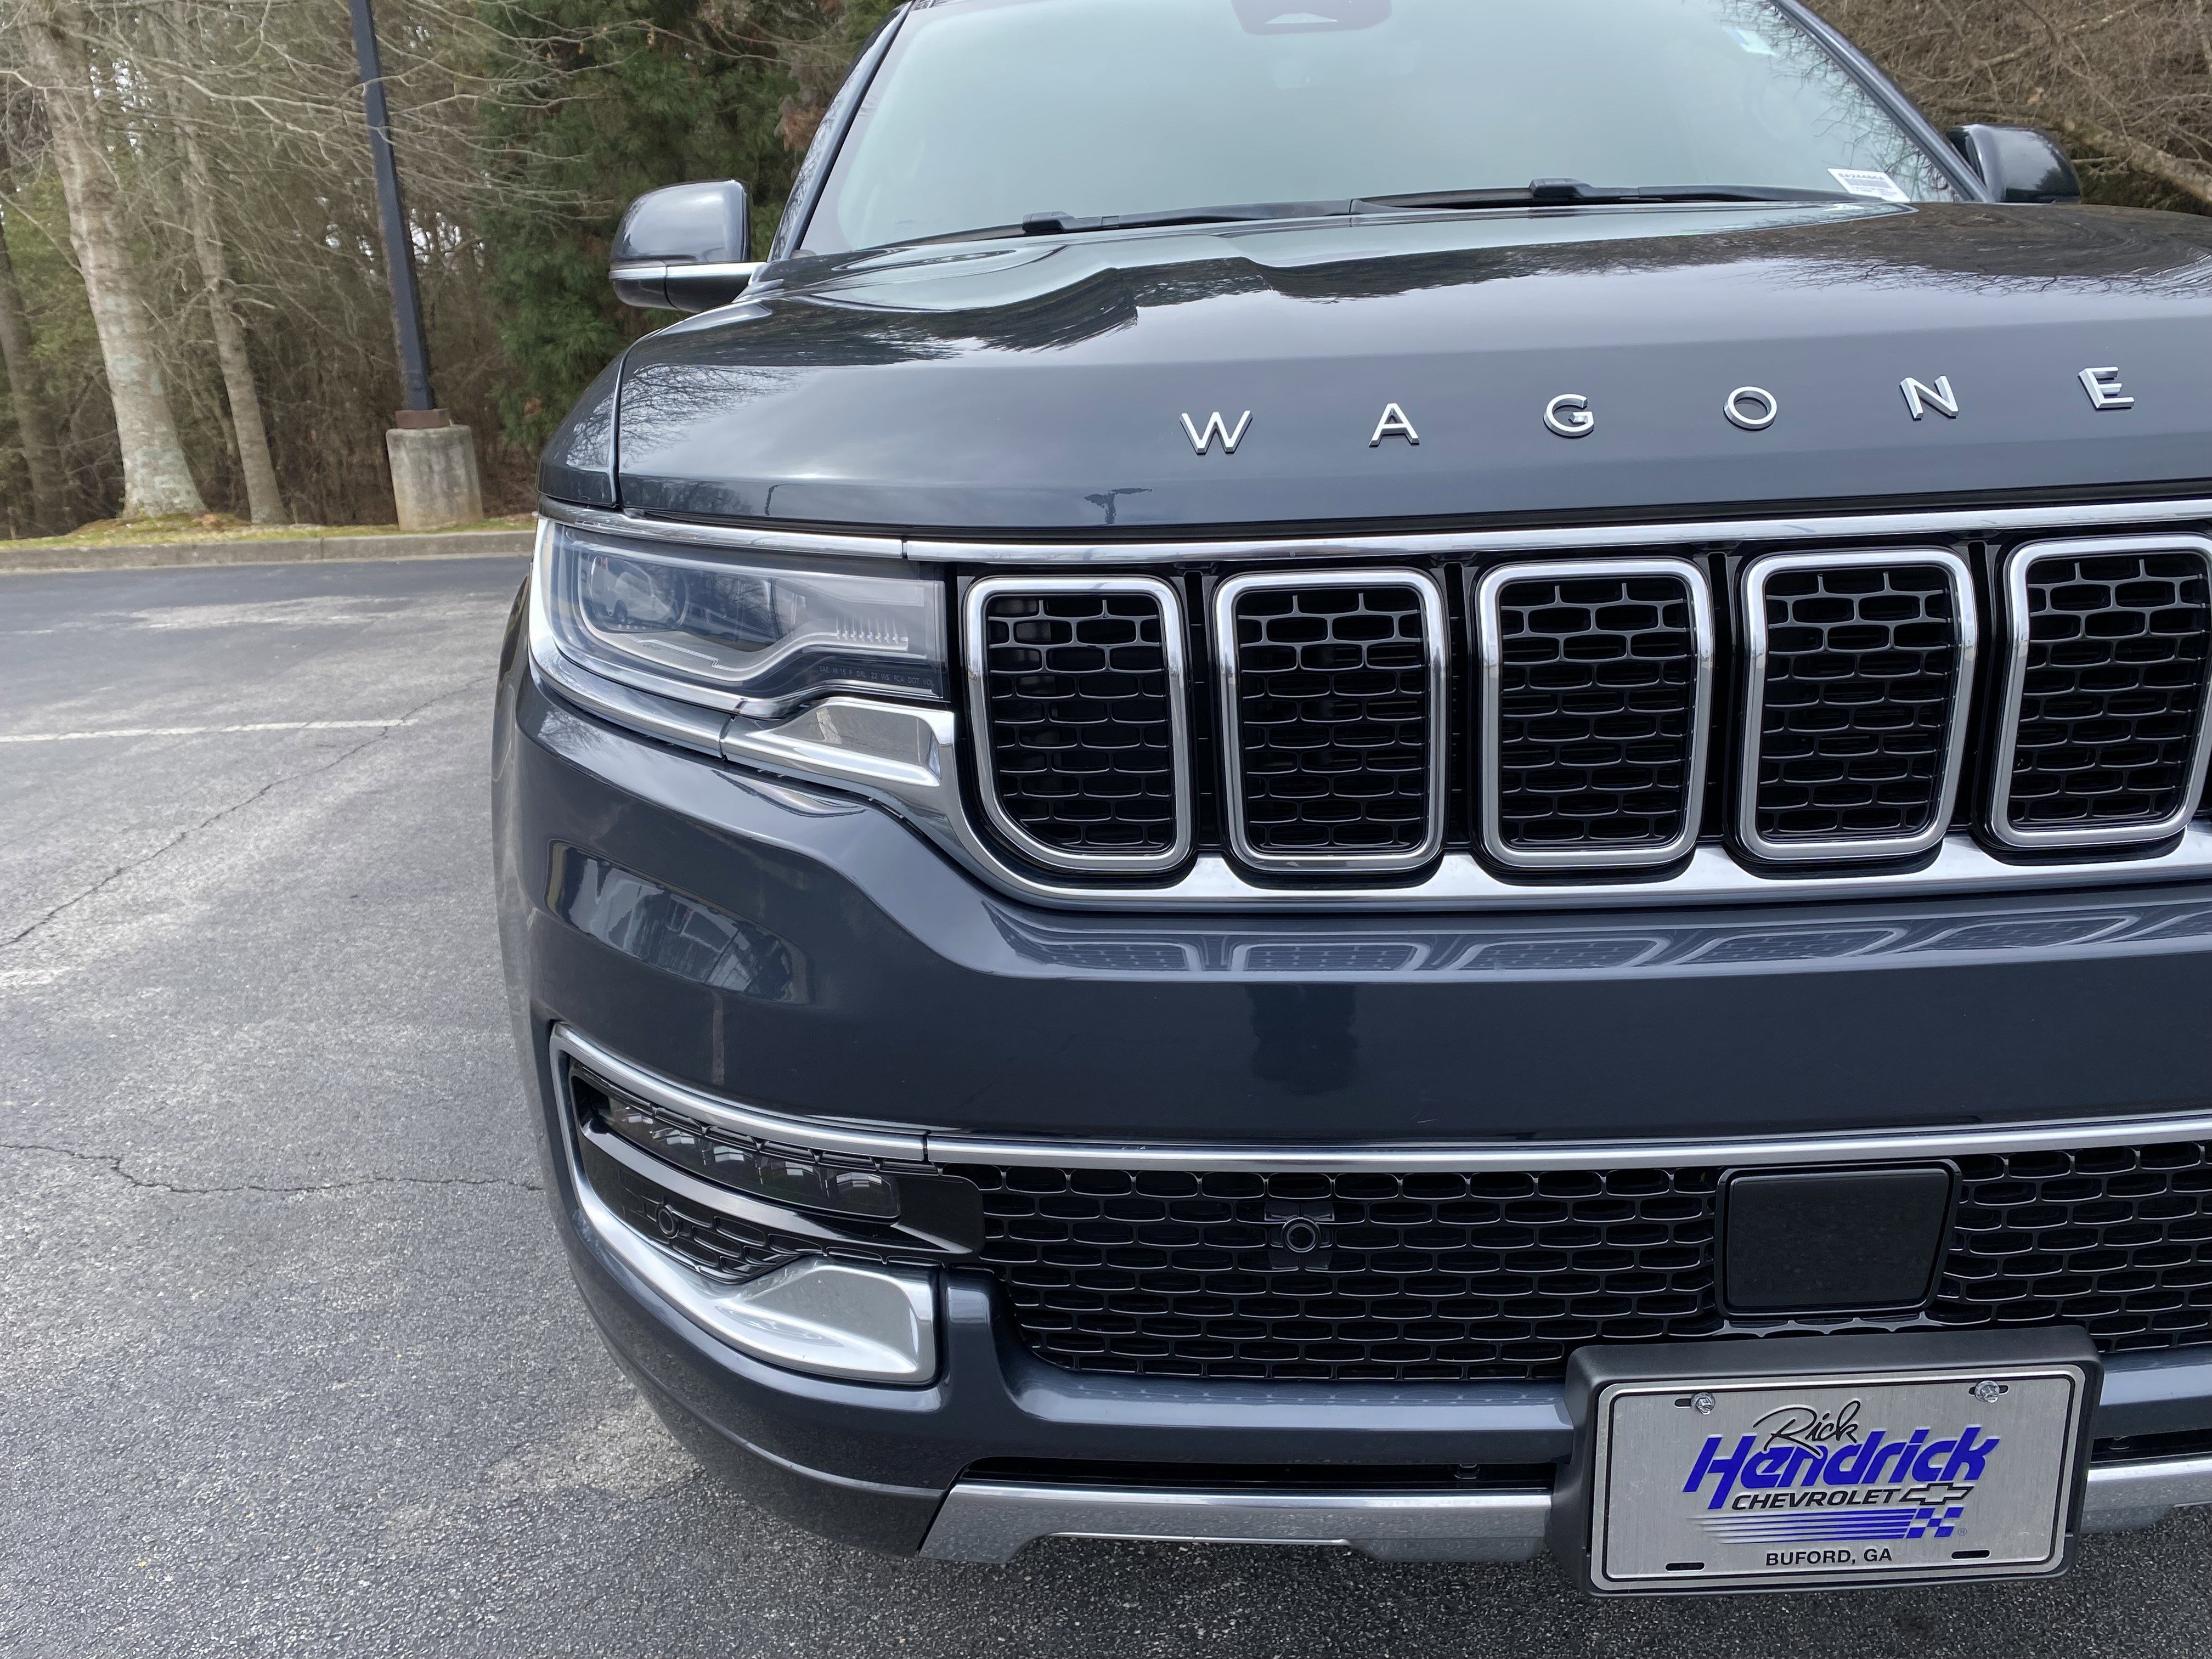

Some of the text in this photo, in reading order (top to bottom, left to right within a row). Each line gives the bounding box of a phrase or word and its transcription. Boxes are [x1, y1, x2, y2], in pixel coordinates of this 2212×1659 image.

[1753, 1400, 1861, 1457] Rick
[1682, 1427, 1999, 1509] Hendrick
[1731, 1488, 1902, 1510] CHEVROLET
[1766, 1548, 1892, 1566] BUFORD, GA
